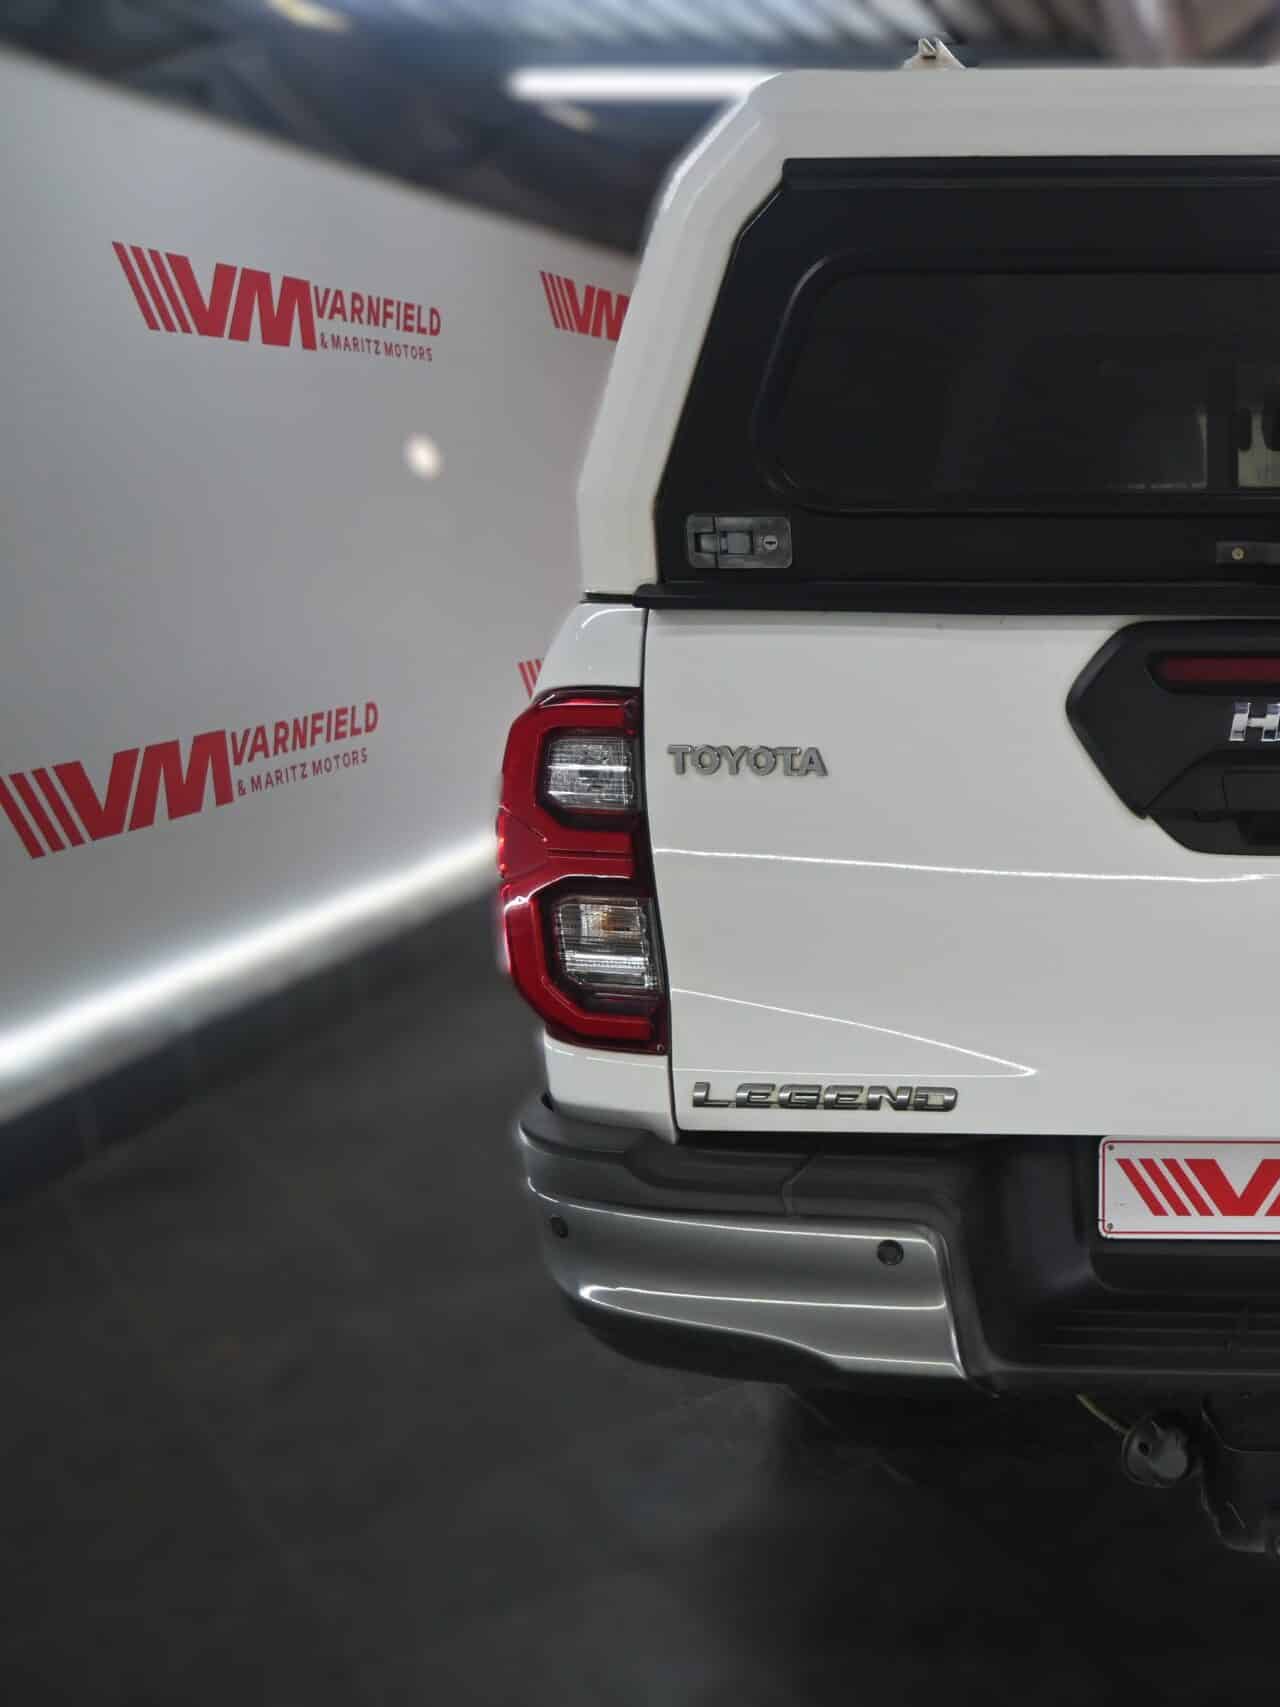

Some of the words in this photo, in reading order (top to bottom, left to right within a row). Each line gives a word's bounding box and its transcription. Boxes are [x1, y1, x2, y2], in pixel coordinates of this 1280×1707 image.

[165, 252, 317, 351] VM
[314, 285, 441, 336] VARNFIELD
[320, 332, 328, 349] &
[331, 334, 380, 355] MARITZ
[384, 341, 432, 362] MOTORS
[231, 701, 379, 766] VARNFIELD
[52, 729, 234, 842] VM
[237, 779, 247, 797] &
[250, 761, 308, 793] MARITZ
[312, 747, 368, 777] MOTORS
[667, 744, 828, 777] TOYOTA
[692, 1082, 959, 1112] LEGEND
